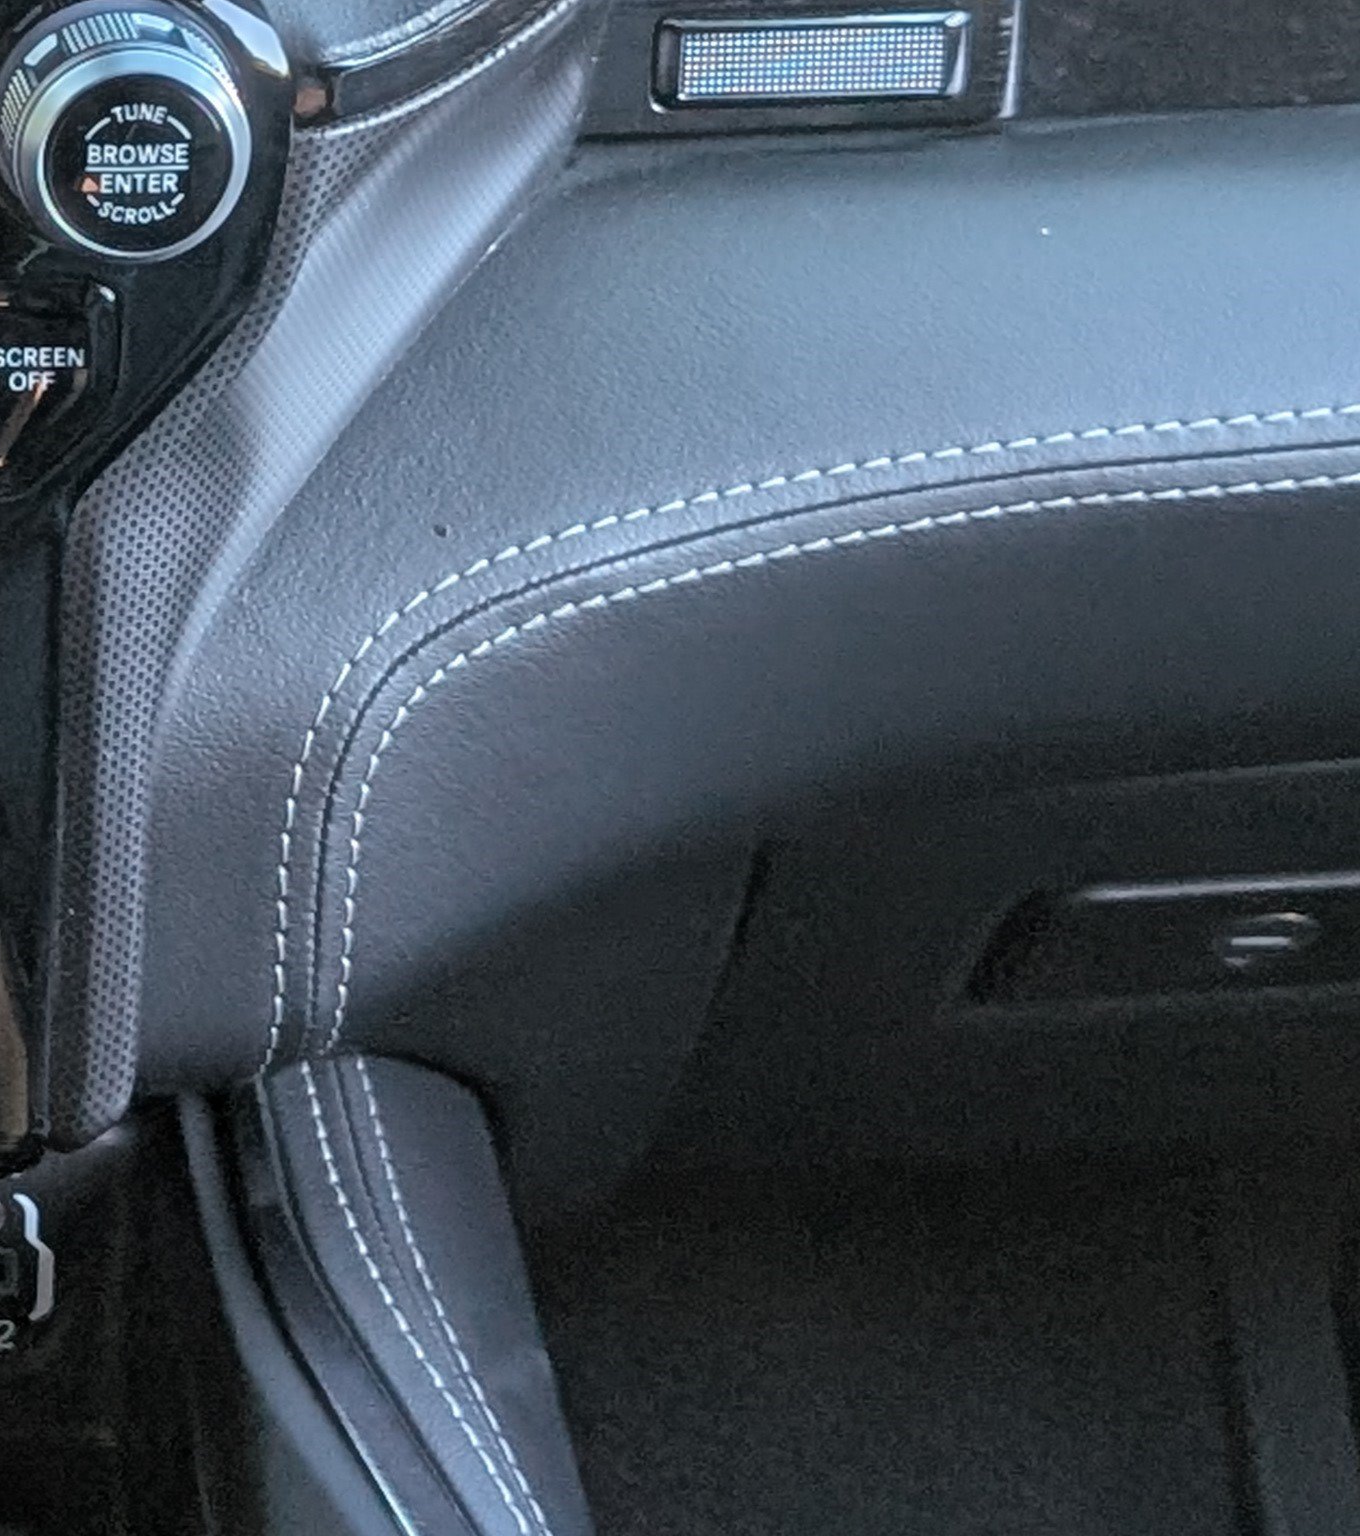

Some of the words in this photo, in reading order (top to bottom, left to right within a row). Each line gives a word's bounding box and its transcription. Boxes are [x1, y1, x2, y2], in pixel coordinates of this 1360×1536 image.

[110, 102, 170, 125] TUNE
[86, 143, 189, 165] BROWSE
[100, 172, 178, 194] ENTER
[97, 200, 176, 225] SCROLL
[8, 370, 55, 392] OFF
